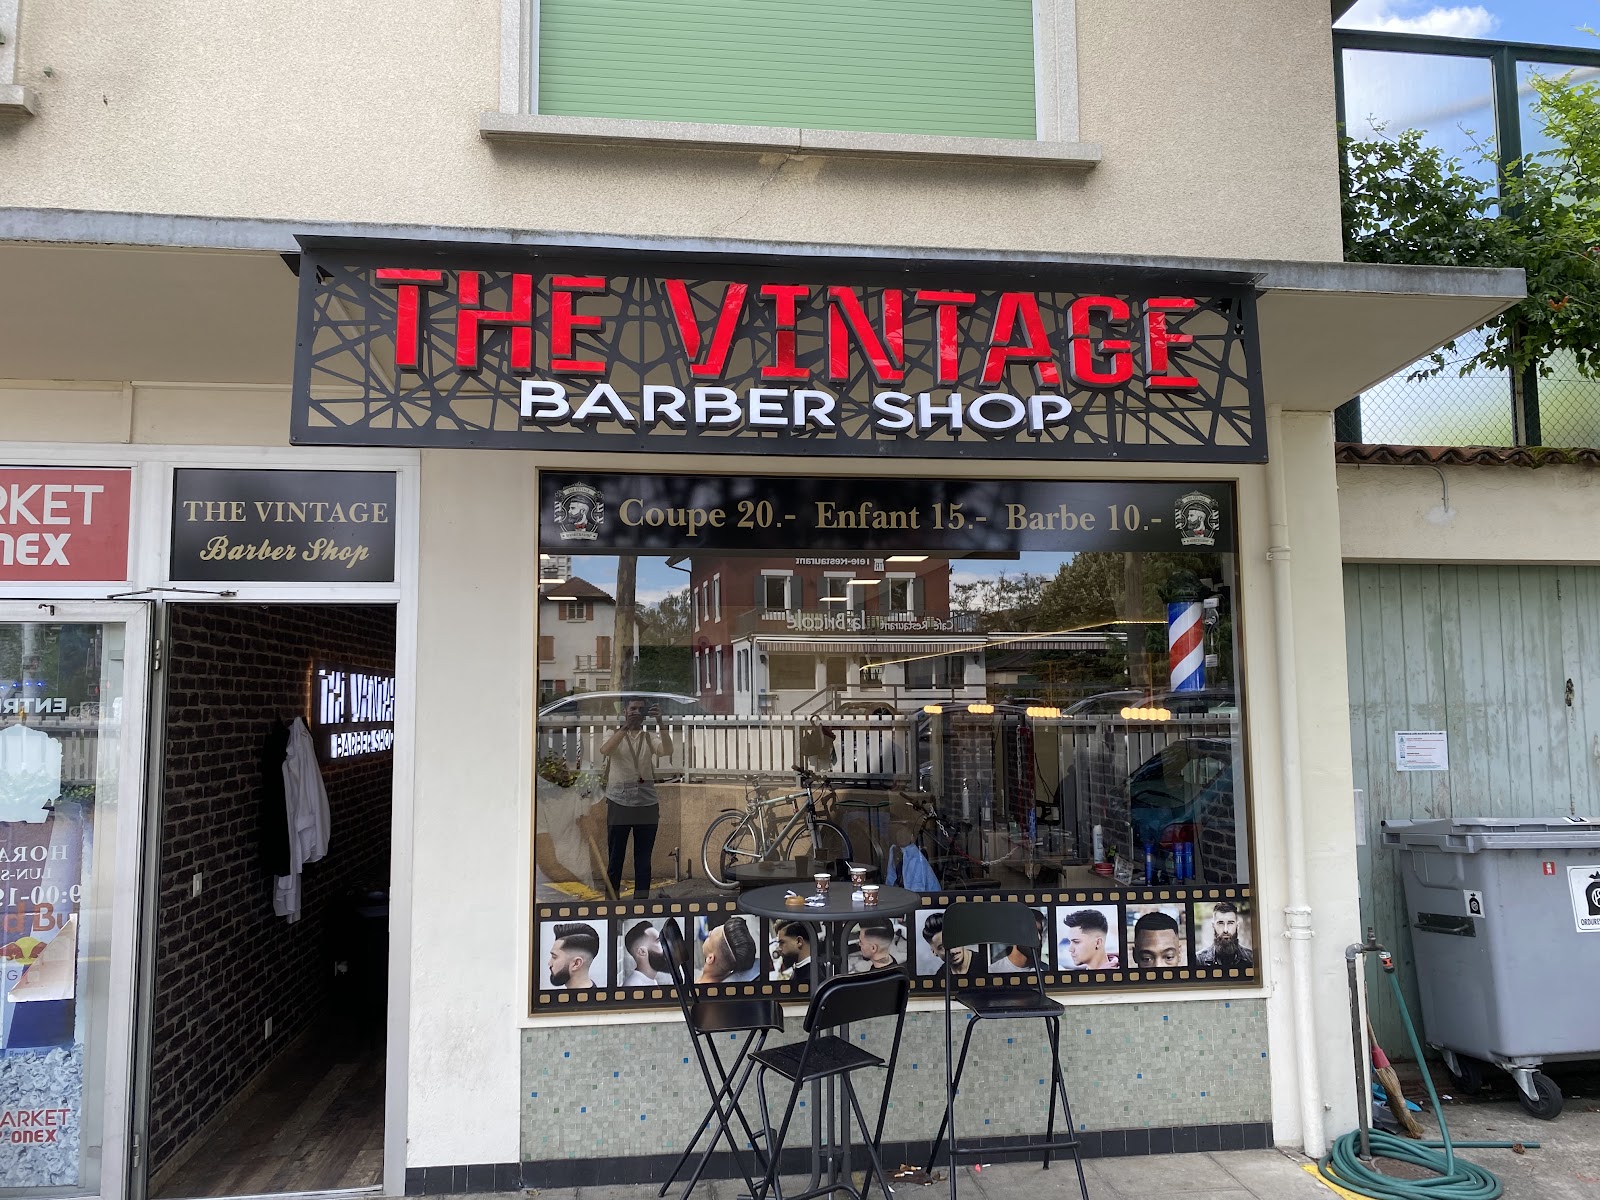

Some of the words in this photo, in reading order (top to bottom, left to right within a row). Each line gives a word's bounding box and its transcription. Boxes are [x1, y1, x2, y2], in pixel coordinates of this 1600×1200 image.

[376, 268, 607, 376] THE
[664, 278, 1199, 391] VINTAGE
[520, 380, 837, 427] BARBER
[873, 391, 1073, 433] SHOP
[183, 501, 247, 522] THE
[254, 501, 388, 523] VINTAGE
[619, 498, 726, 537] Coupe
[737, 500, 796, 530] 20.-
[815, 501, 920, 529] Enfant
[932, 503, 987, 530] 15.-
[1005, 503, 1096, 531] Barbe
[1108, 504, 1162, 531] 10.-
[200, 534, 296, 561] Barber
[302, 537, 370, 568] Shop
